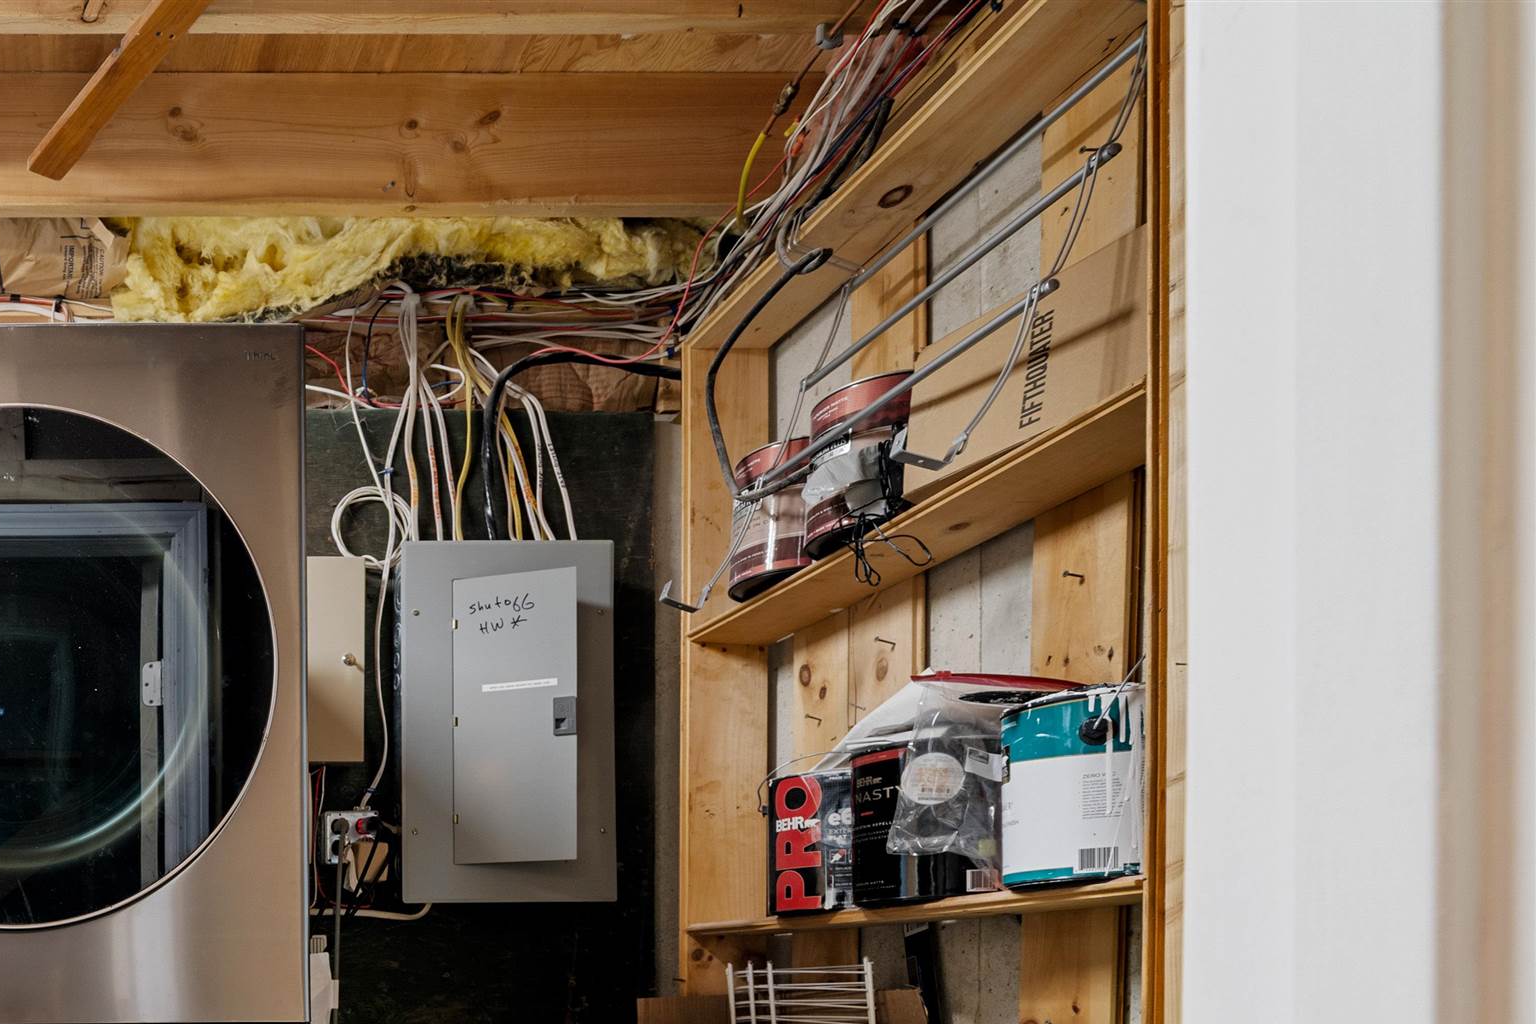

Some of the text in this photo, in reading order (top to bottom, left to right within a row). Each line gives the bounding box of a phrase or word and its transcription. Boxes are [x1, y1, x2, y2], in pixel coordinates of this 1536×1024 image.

[480, 617, 504, 634] HW
[776, 816, 805, 832] BEHR
[775, 776, 823, 912] PRO
